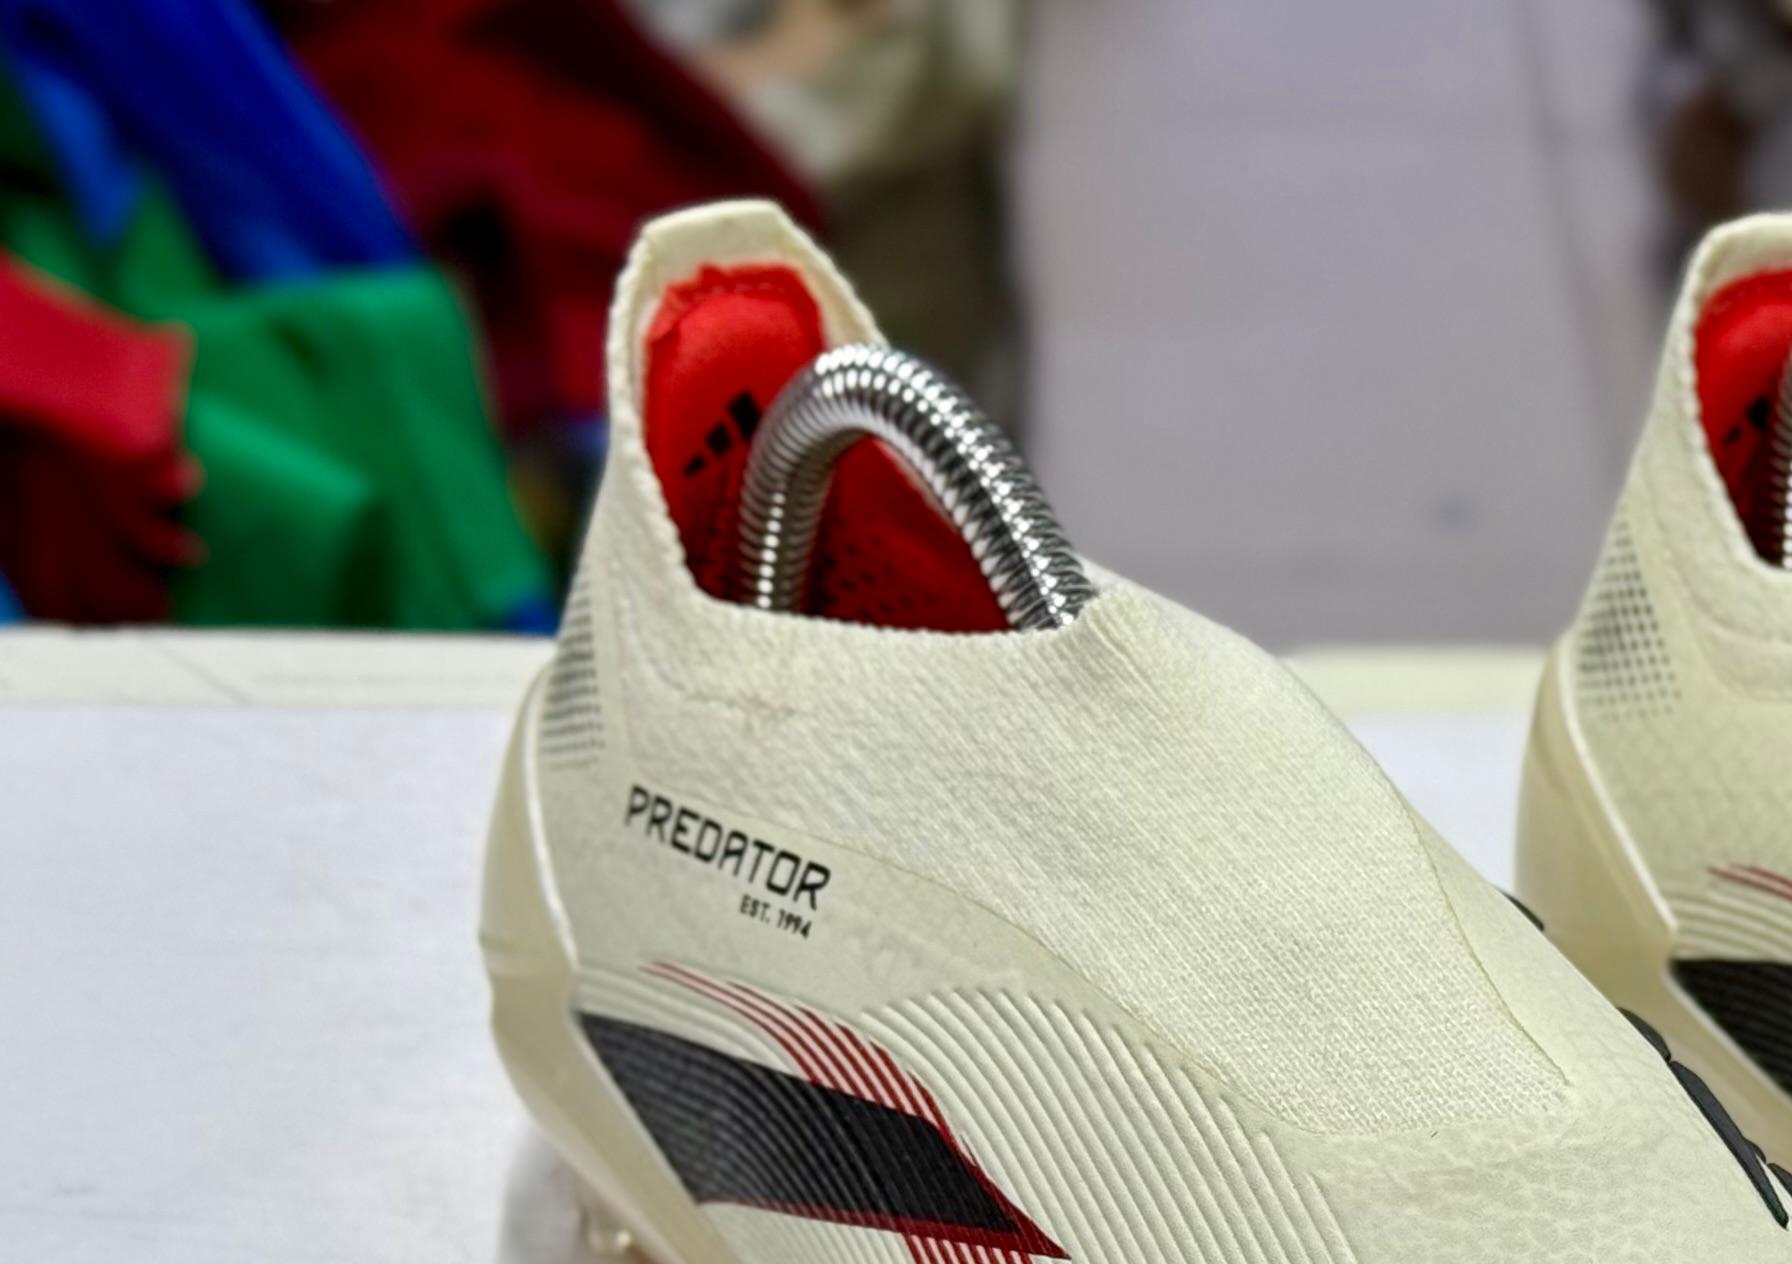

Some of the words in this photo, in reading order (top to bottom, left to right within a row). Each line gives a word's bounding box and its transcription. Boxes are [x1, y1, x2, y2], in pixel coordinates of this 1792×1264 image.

[625, 784, 831, 911] PREDATOR
[739, 894, 771, 924] EST.
[776, 908, 812, 939] 1994
